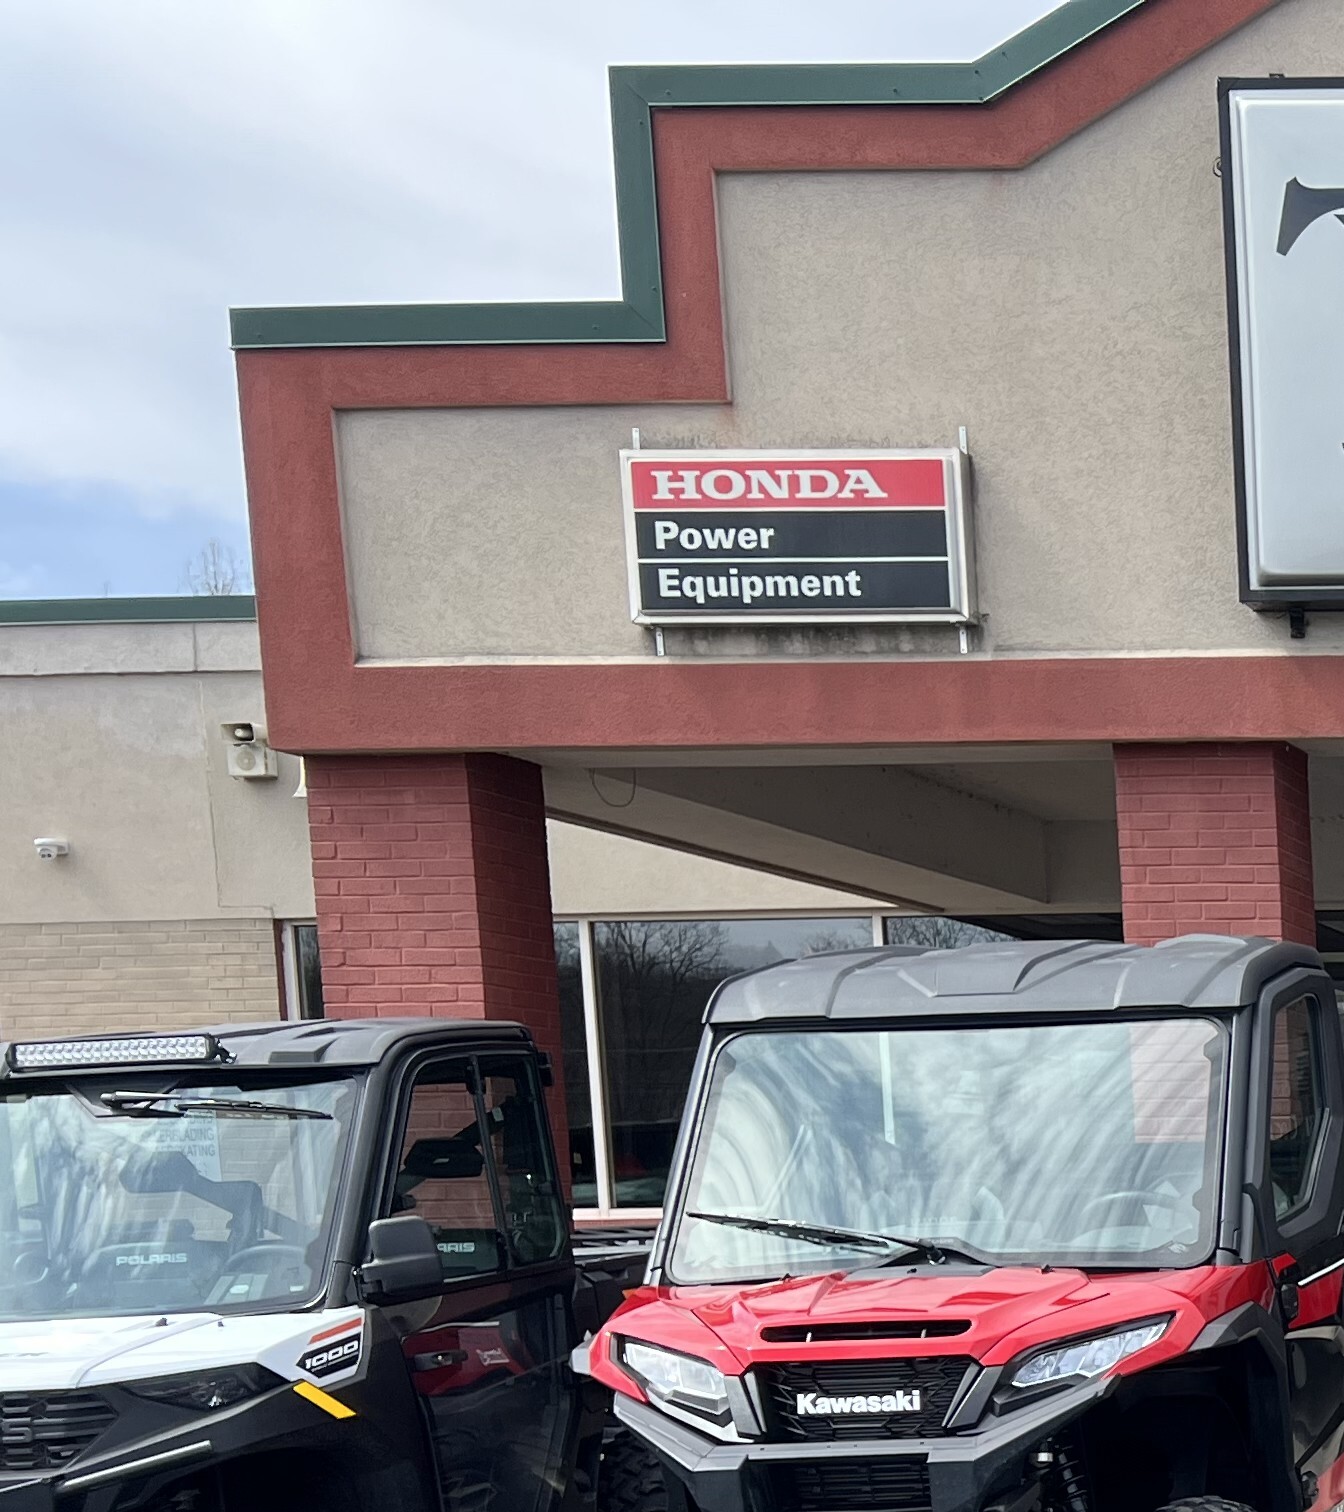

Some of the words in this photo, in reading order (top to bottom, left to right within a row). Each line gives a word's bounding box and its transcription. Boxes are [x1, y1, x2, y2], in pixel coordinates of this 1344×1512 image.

[650, 469, 888, 500] HONDA
[654, 520, 775, 549] Power
[657, 568, 862, 604] Equipment
[115, 1252, 188, 1266] POLARIS
[305, 1340, 359, 1369] 1000
[796, 1389, 921, 1415] Kawasaki
